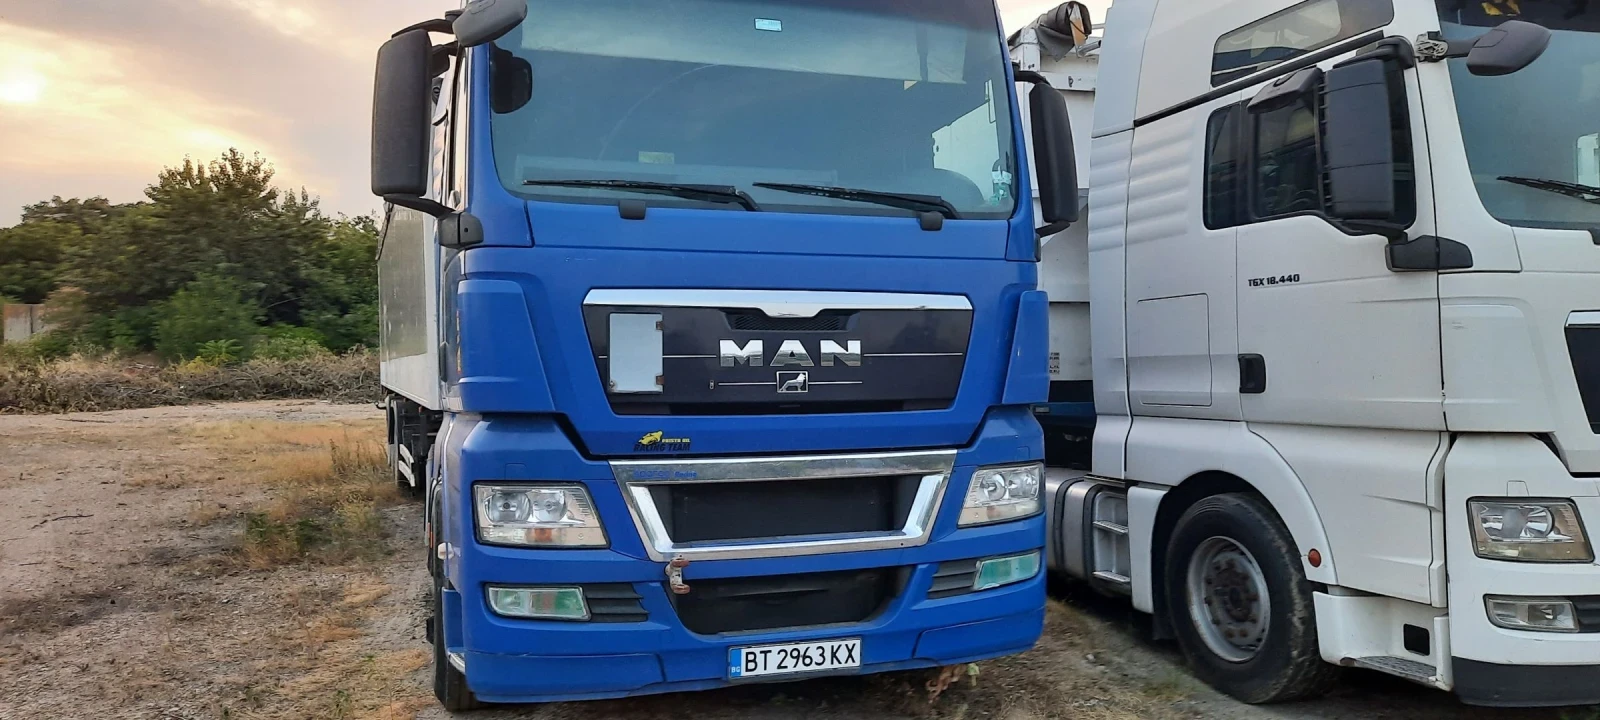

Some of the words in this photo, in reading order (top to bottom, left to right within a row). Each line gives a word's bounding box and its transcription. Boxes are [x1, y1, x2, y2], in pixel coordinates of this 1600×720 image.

[1248, 277, 1265, 287] TGX
[1266, 273, 1300, 285] 18.440
[719, 339, 861, 367] MAN
[633, 443, 665, 452] RACING
[668, 443, 691, 452] TEAM
[744, 649, 772, 673] BT
[776, 645, 826, 670] 2963
[830, 643, 857, 665] KX
